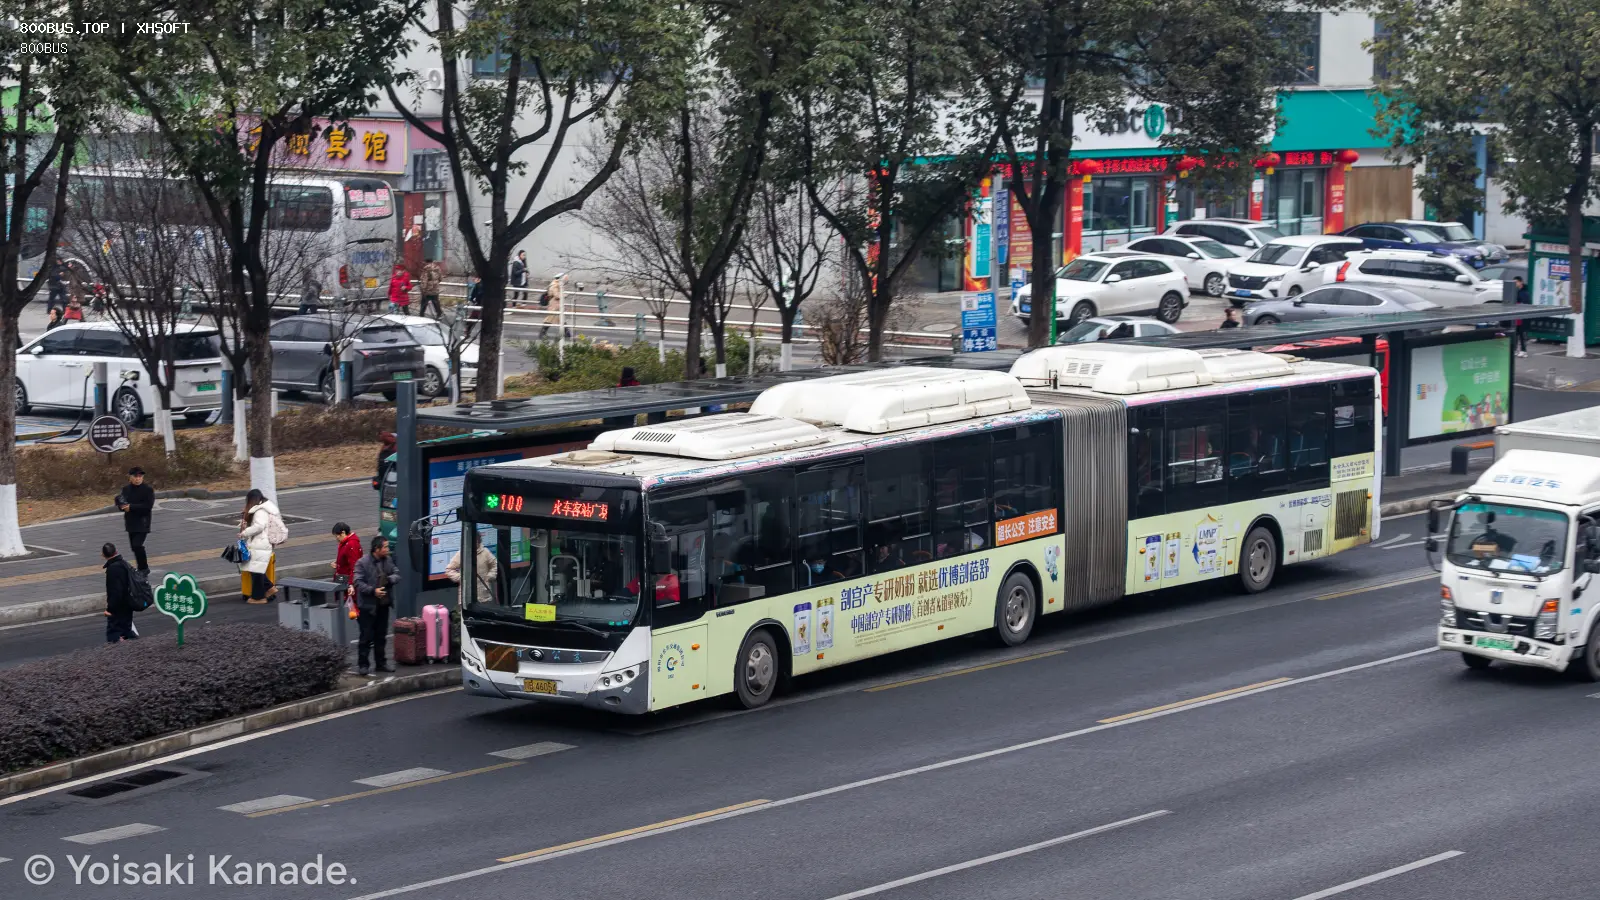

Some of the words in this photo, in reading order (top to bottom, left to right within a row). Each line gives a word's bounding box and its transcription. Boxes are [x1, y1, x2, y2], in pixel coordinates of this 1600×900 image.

[964, 336, 996, 351] 停车场
[500, 494, 524, 512] 100
[551, 499, 608, 521] 火车客站广场
[997, 521, 1026, 542] 超长公交
[1027, 513, 1055, 534] 注意安全
[840, 573, 915, 611] 剖宫产专研奶粉
[917, 557, 990, 594] 就选优博剖蓓舒
[851, 602, 912, 634] 中国剖宫产专研奶粉
